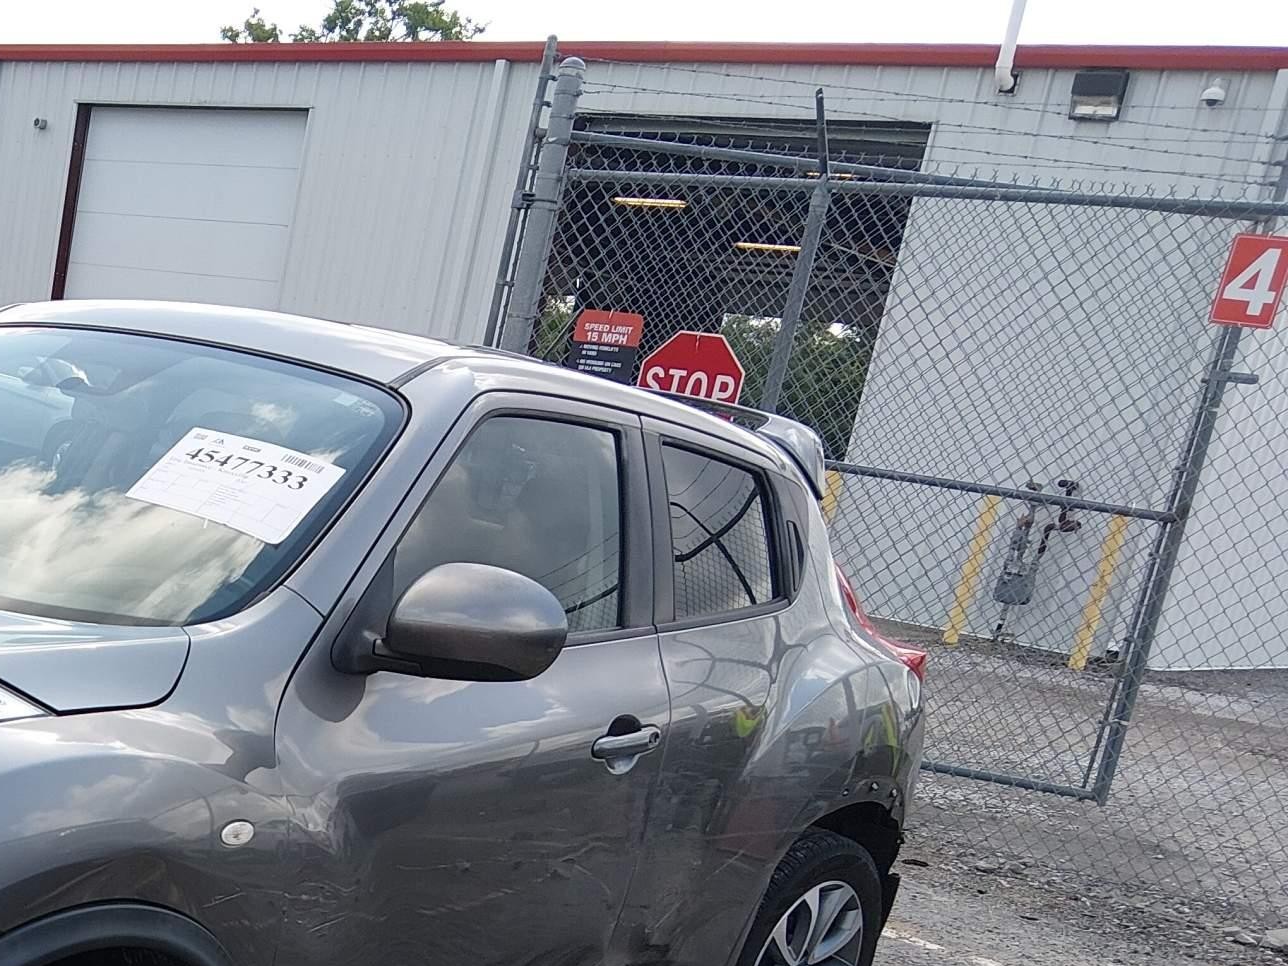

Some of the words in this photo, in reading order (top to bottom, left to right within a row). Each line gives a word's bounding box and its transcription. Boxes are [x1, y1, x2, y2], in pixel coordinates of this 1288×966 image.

[1222, 247, 1283, 317] 4
[584, 322, 610, 332] SPEED
[611, 325, 634, 335] LIMIT
[587, 331, 599, 342] 15
[601, 332, 628, 345] MPH
[646, 366, 735, 401] STOP
[185, 447, 308, 491] 45477333
